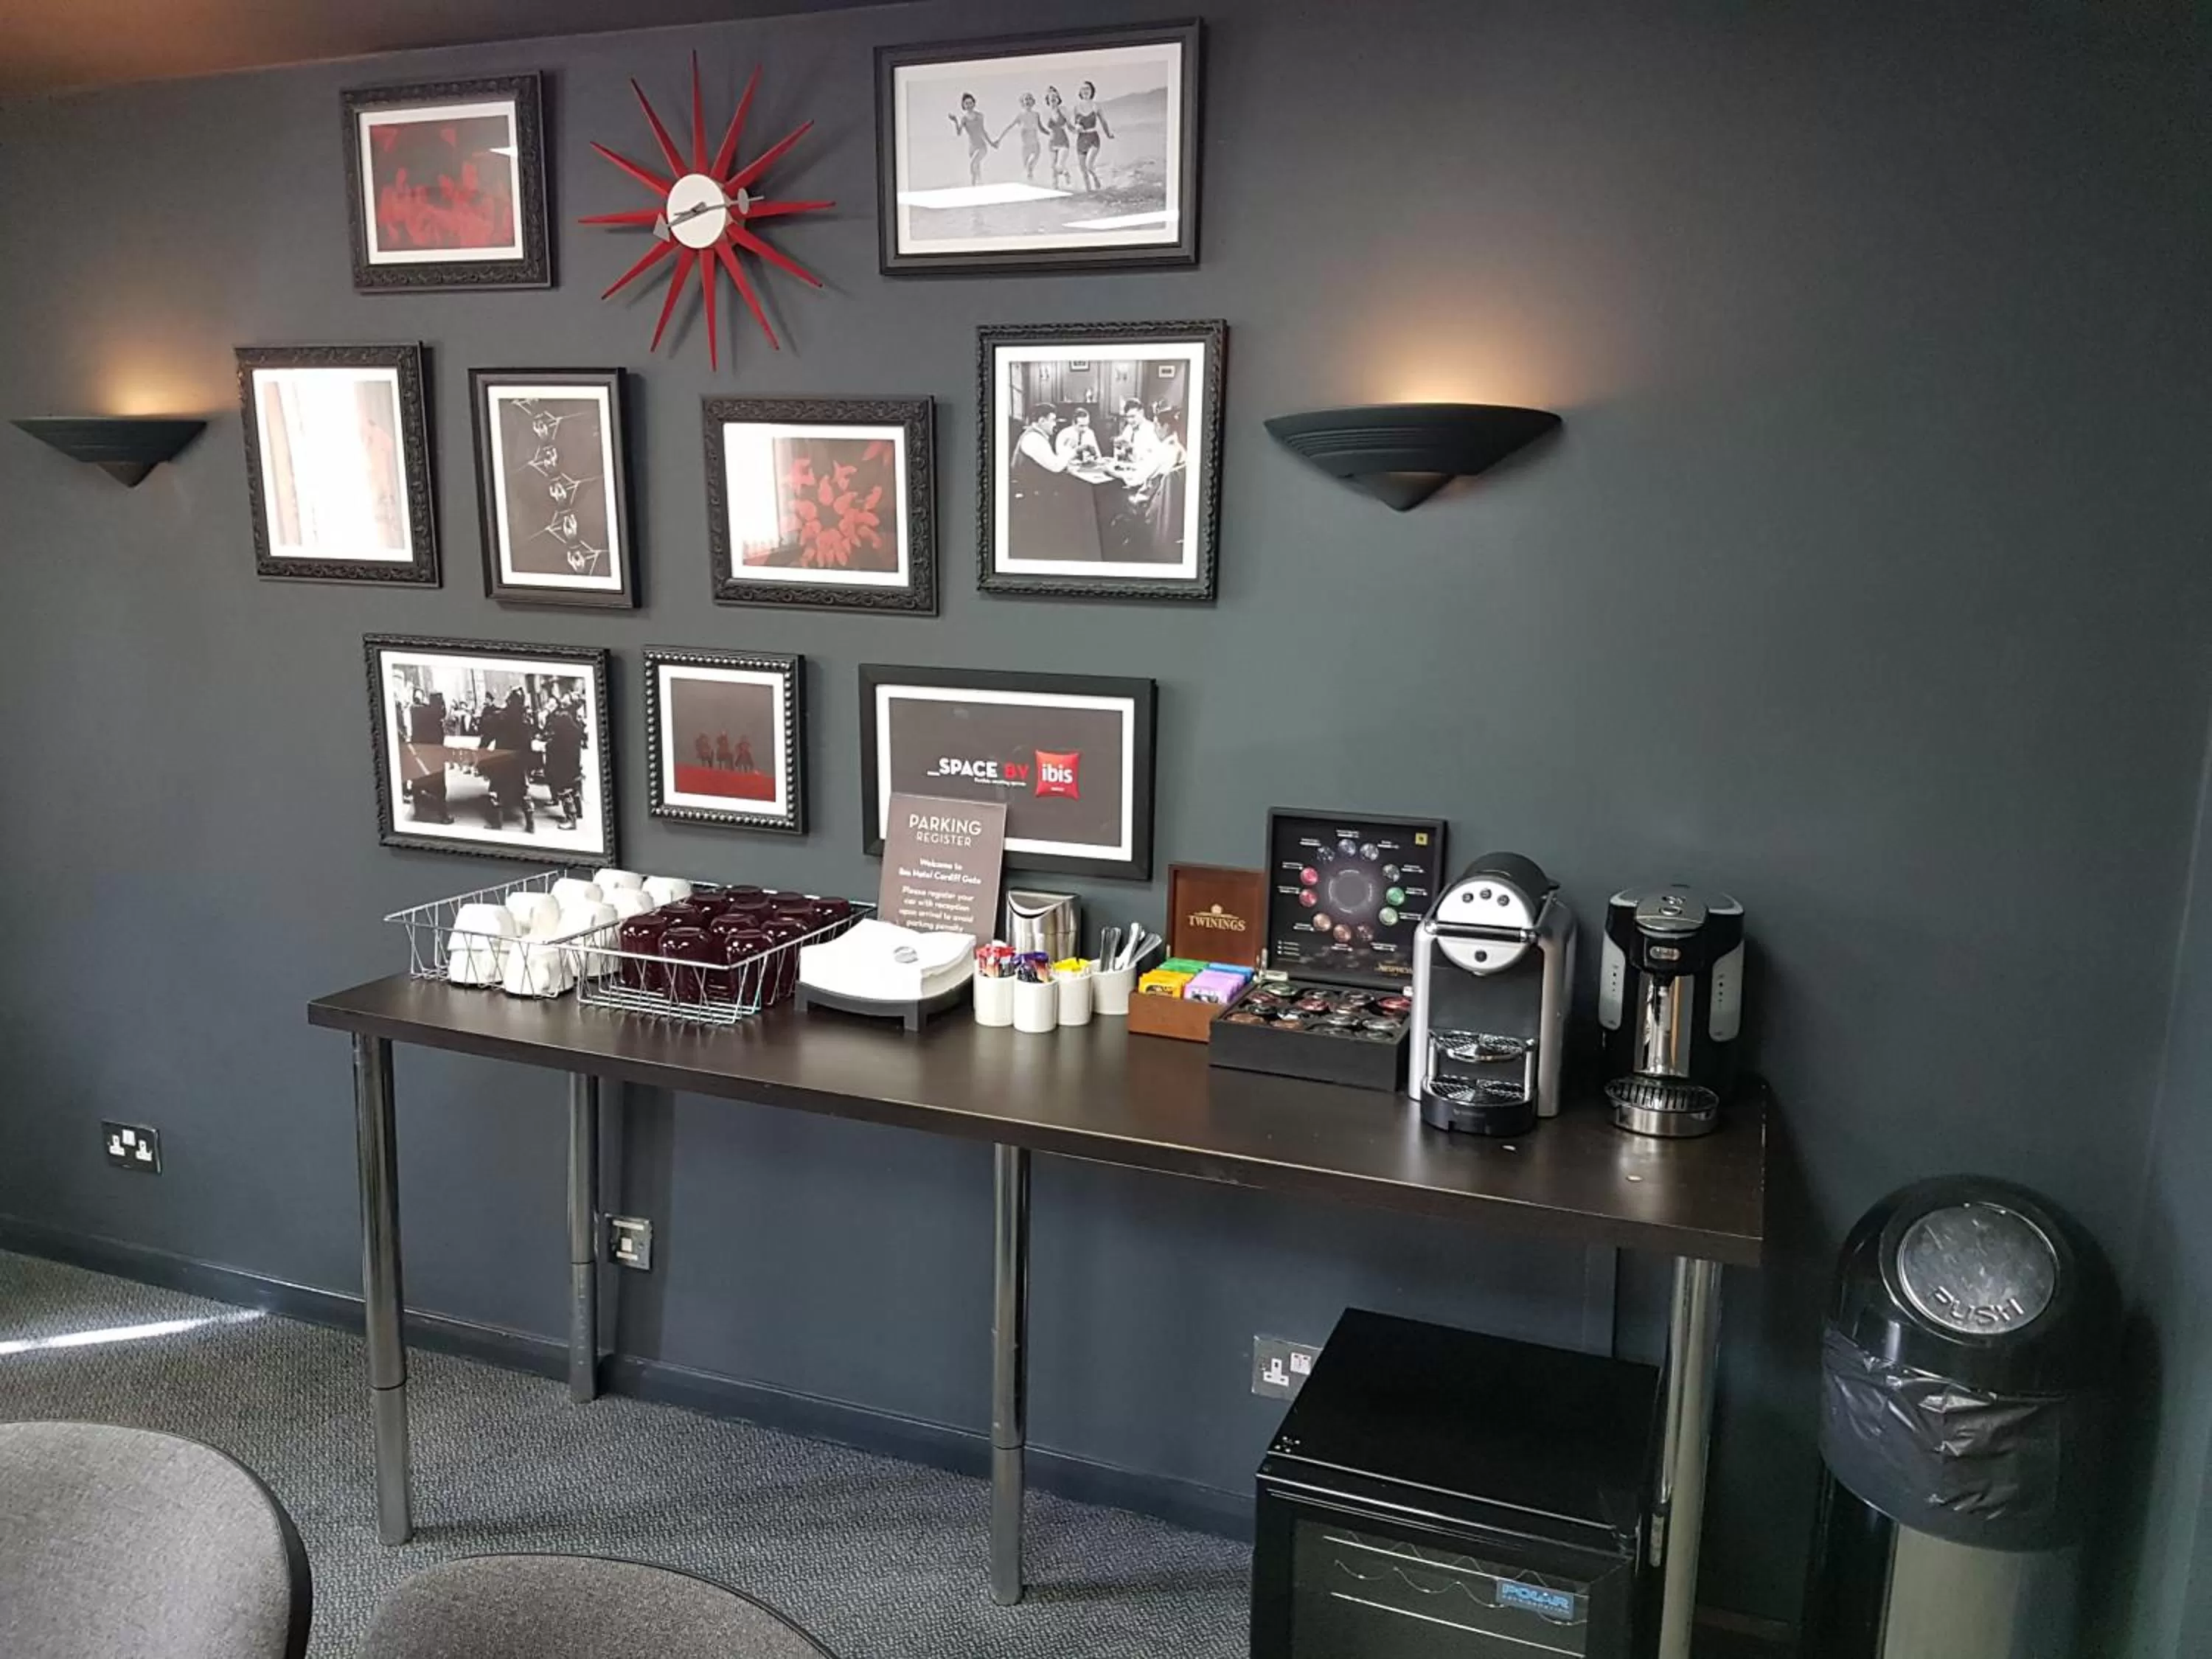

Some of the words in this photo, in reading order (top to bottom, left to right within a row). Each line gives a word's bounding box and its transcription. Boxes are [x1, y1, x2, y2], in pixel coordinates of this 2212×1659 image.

[1003, 762, 1029, 779] BY
[1042, 763, 1074, 784] ibis
[908, 813, 982, 835] PARKING
[916, 832, 972, 846] REGISTER
[919, 858, 953, 869] Welcome
[954, 861, 963, 871] to
[913, 869, 933, 878] Hotel
[934, 872, 961, 882] Cardiff
[962, 875, 981, 884] Gate
[902, 886, 926, 896] Please
[928, 890, 956, 900] register
[958, 894, 975, 902] your
[918, 899, 933, 907] with
[935, 902, 970, 912] reception
[919, 910, 942, 919] arrival
[953, 914, 974, 923] avoid
[1188, 915, 1245, 931] TWININGS
[905, 920, 934, 931] parking
[1933, 1285, 2025, 1325] PUSH
